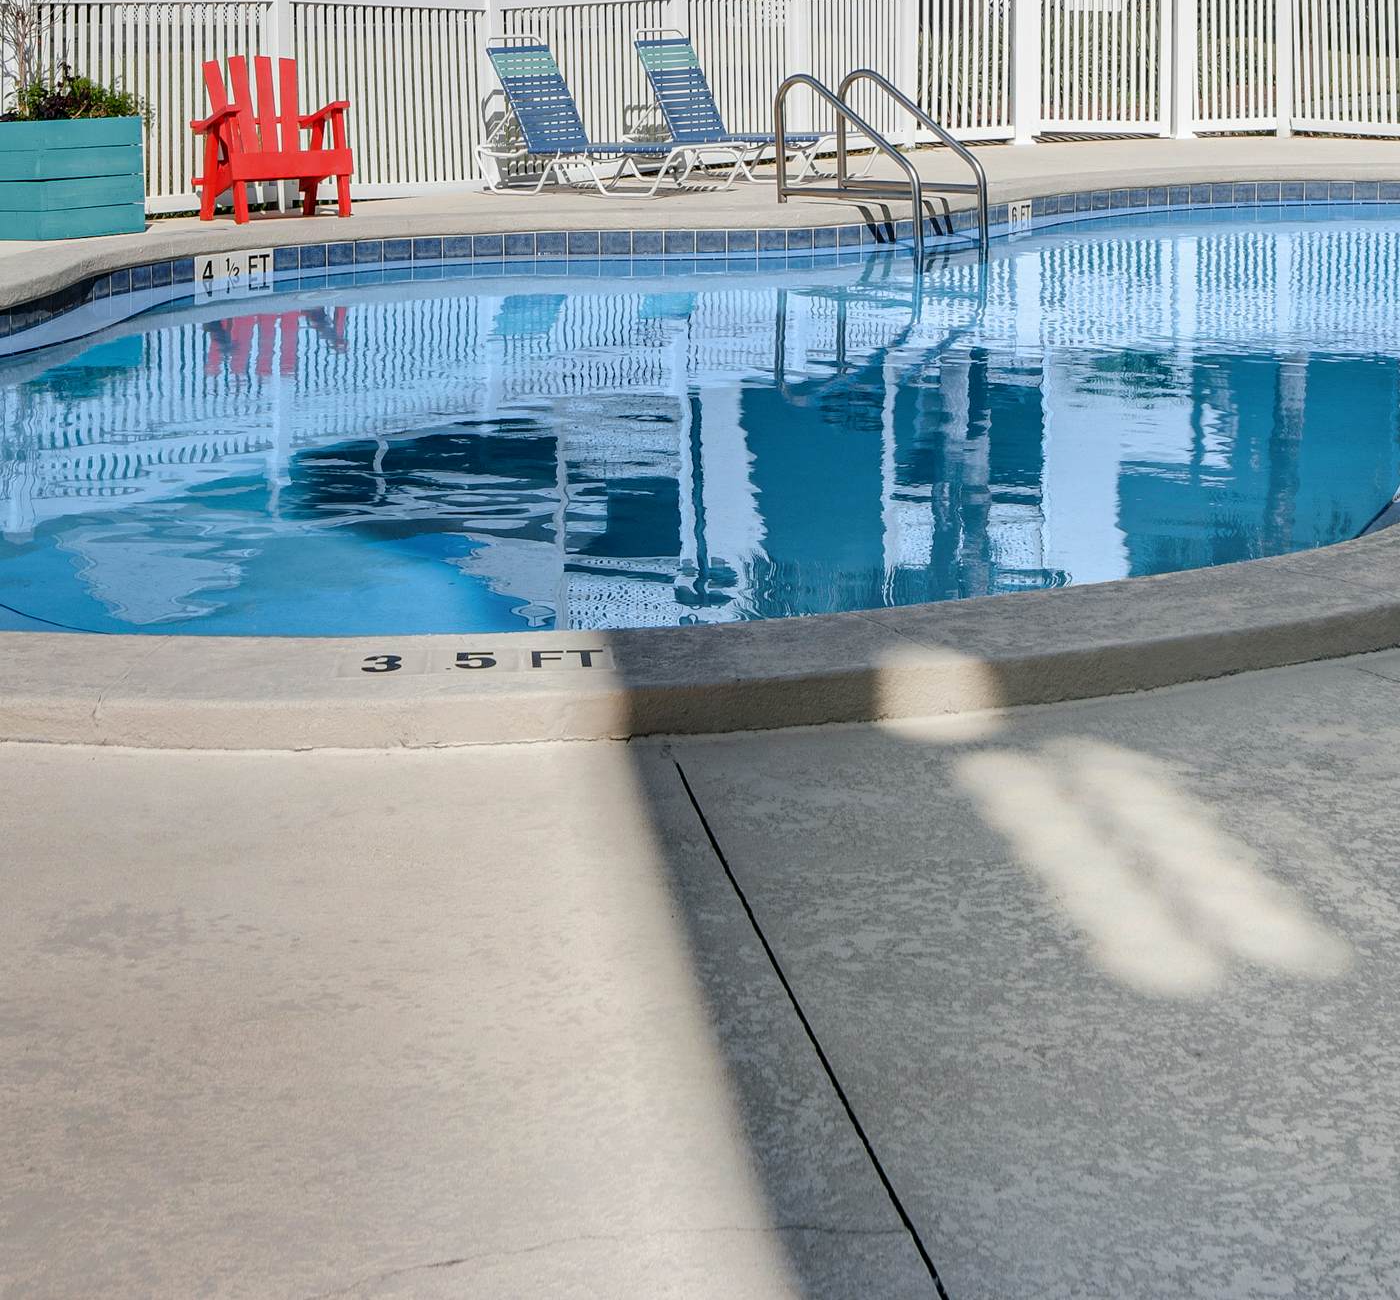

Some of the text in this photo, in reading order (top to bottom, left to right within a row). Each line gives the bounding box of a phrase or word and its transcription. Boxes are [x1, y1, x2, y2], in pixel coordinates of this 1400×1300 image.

[202, 260, 214, 279] 4
[248, 253, 271, 275] FT
[361, 654, 402, 673] 3
[531, 649, 603, 668] FT
